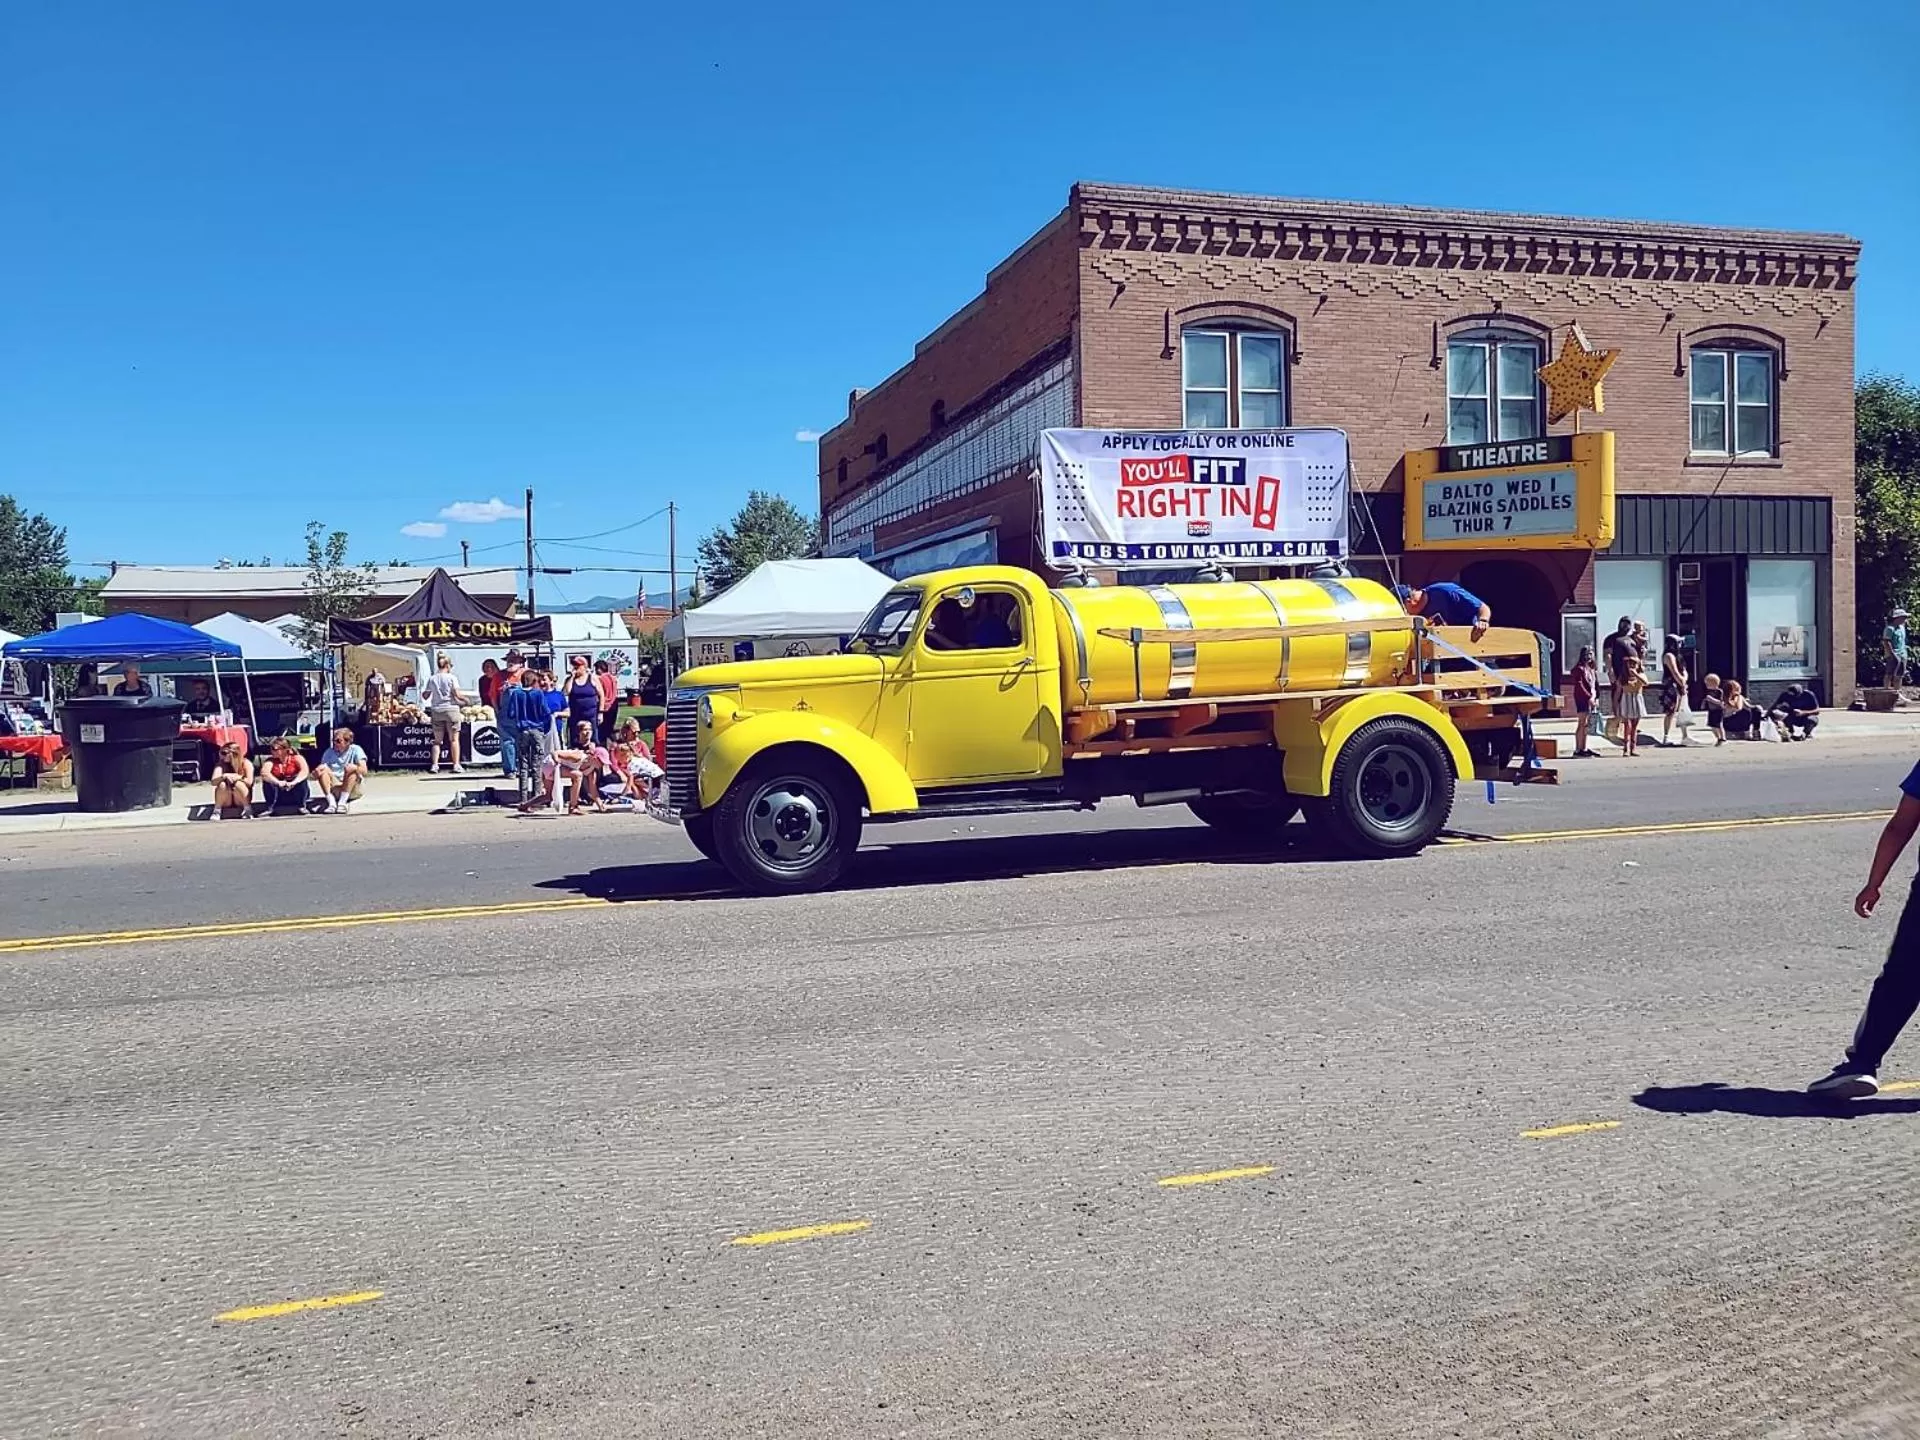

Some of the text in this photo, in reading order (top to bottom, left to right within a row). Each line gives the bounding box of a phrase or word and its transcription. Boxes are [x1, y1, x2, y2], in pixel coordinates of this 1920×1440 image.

[1102, 435, 1296, 451] APPLY LOCALLY OR ONLINE
[1458, 442, 1548, 468] THEATRE
[1122, 459, 1240, 483] YOU'LL FIT
[1442, 482, 1494, 500] BALTO
[1506, 479, 1541, 495] WED
[1117, 488, 1212, 518] RIGHT
[1427, 494, 1572, 517] BLAZING SADDLES
[1453, 516, 1513, 533] THUR 7
[371, 622, 512, 640] KETTLE CORN
[702, 643, 725, 654] FREE
